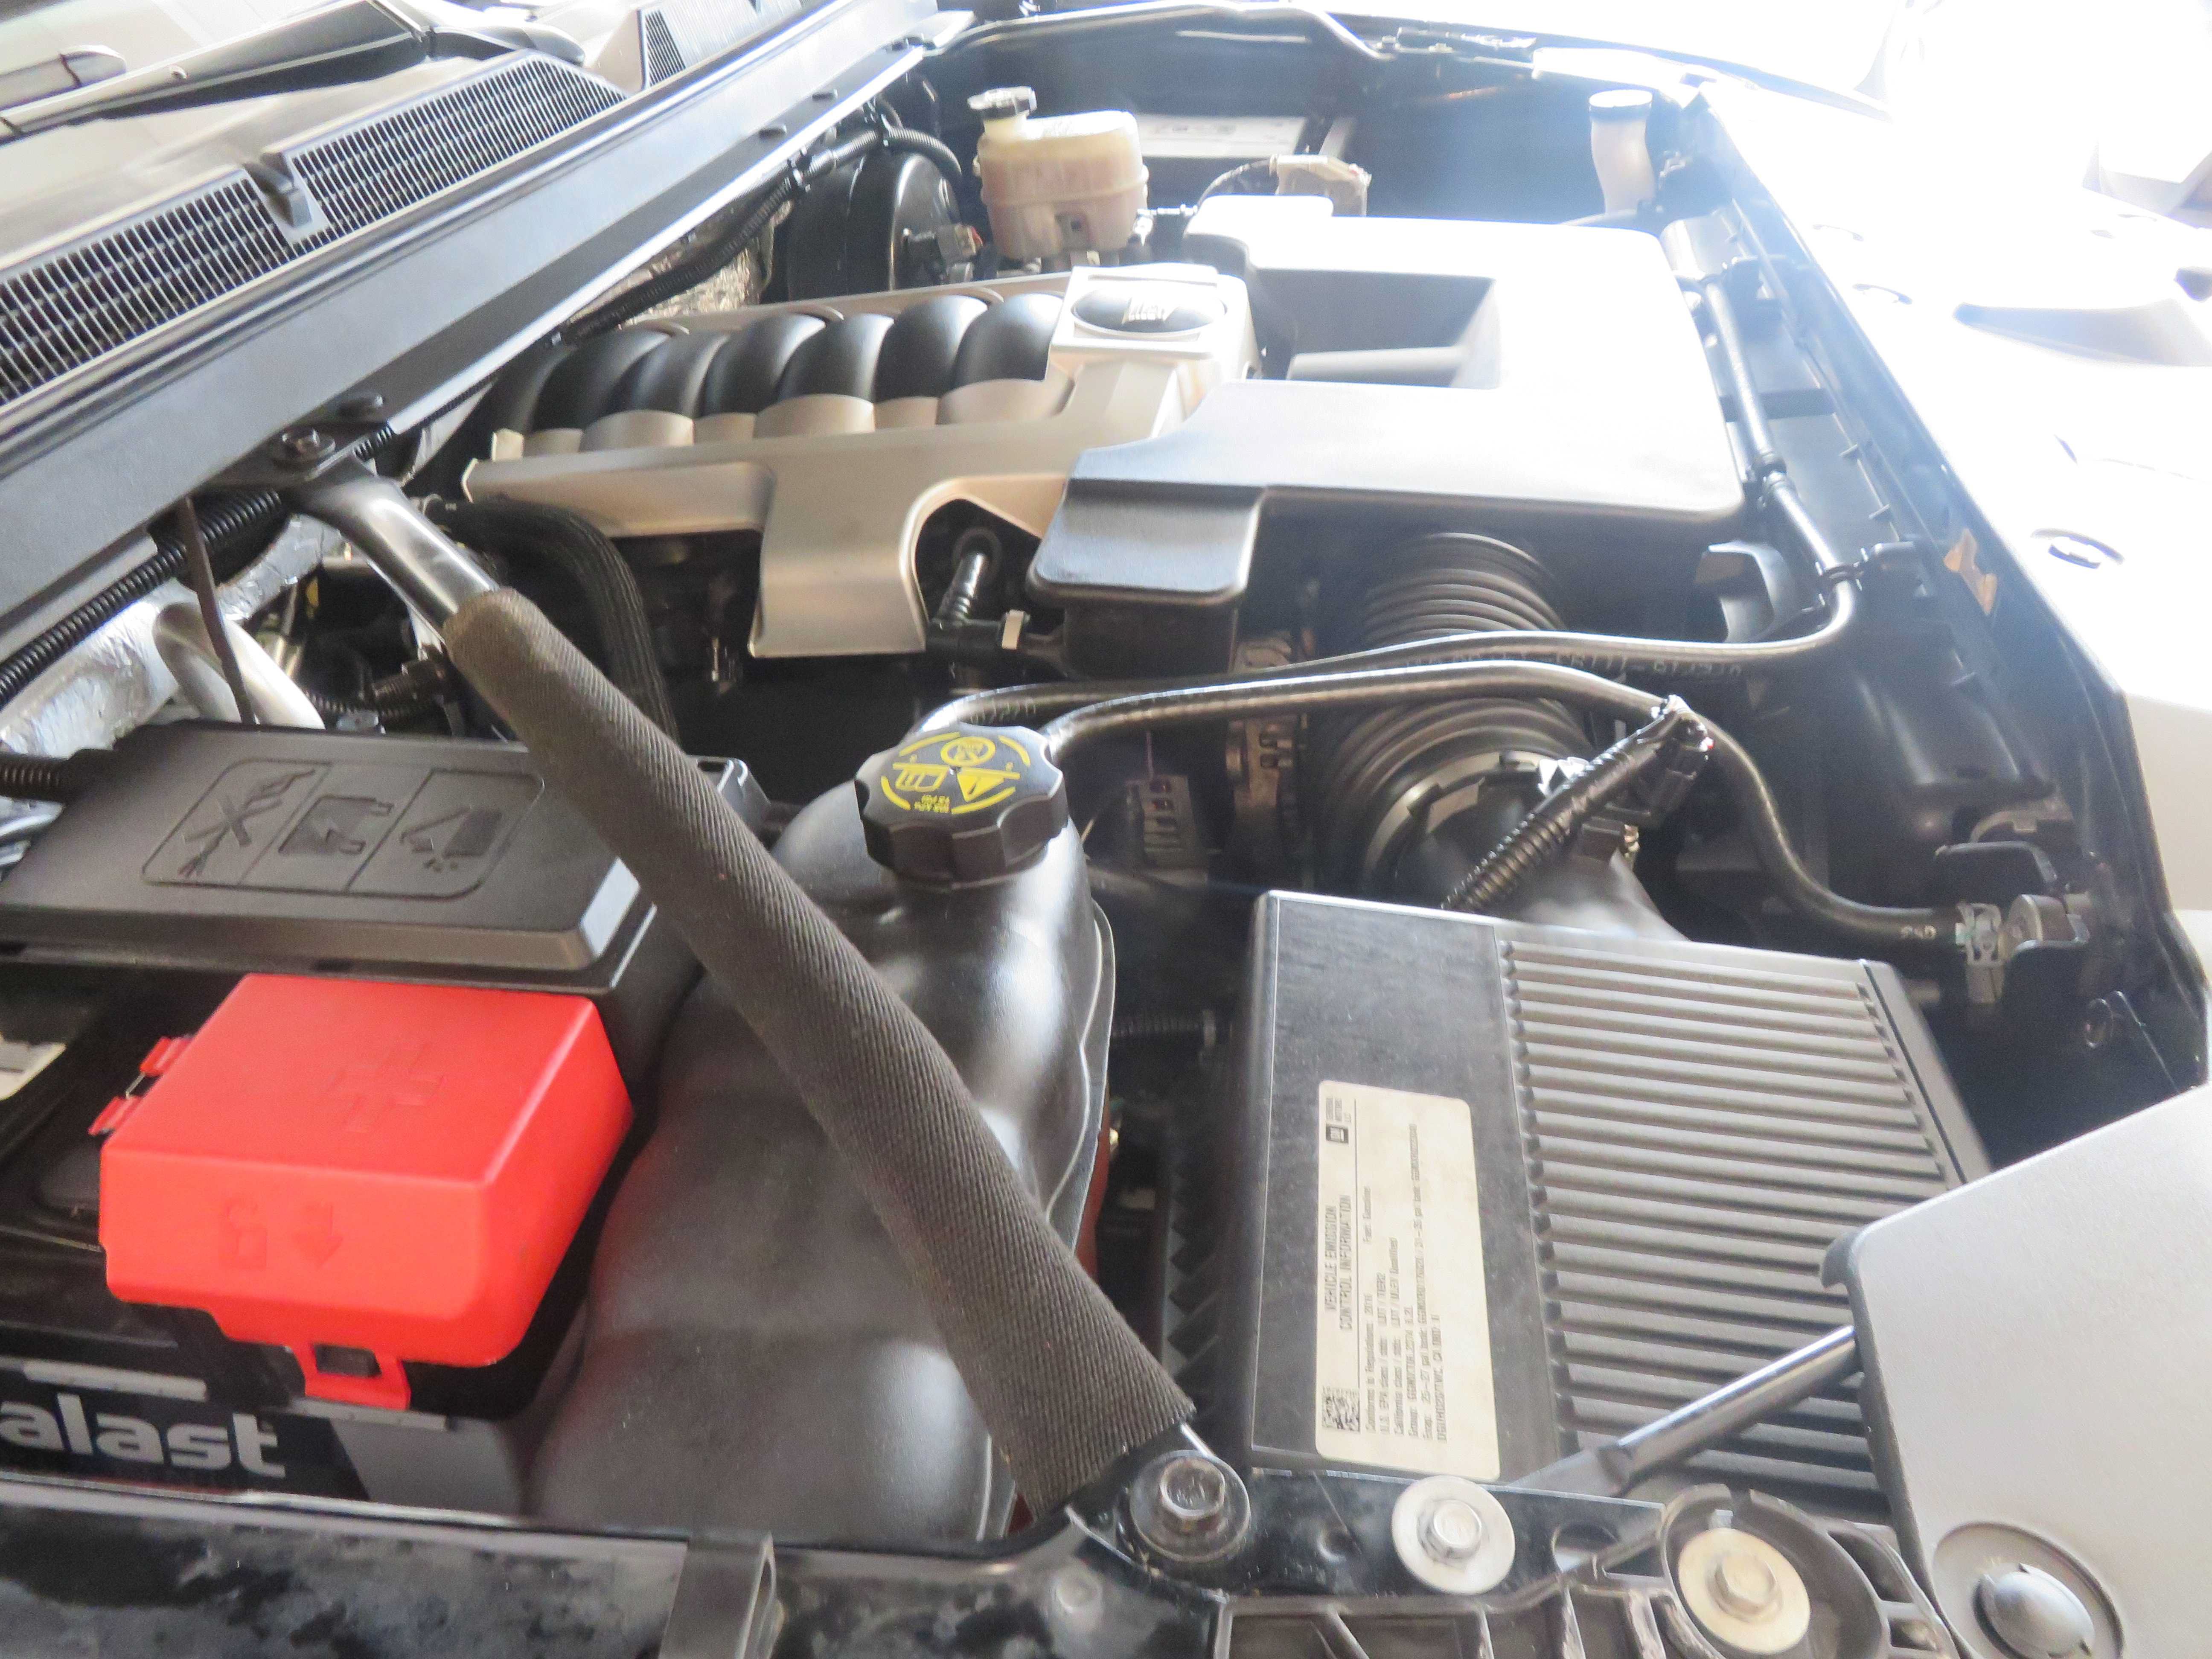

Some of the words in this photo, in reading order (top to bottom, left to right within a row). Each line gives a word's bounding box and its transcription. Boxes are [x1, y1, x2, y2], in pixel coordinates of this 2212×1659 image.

[1324, 1206, 1336, 1260] EMISSION
[1339, 1195, 1352, 1271] INFORMATION
[1324, 1263, 1336, 1312] VEHICLE
[1340, 1277, 1352, 1330] CONTROL
